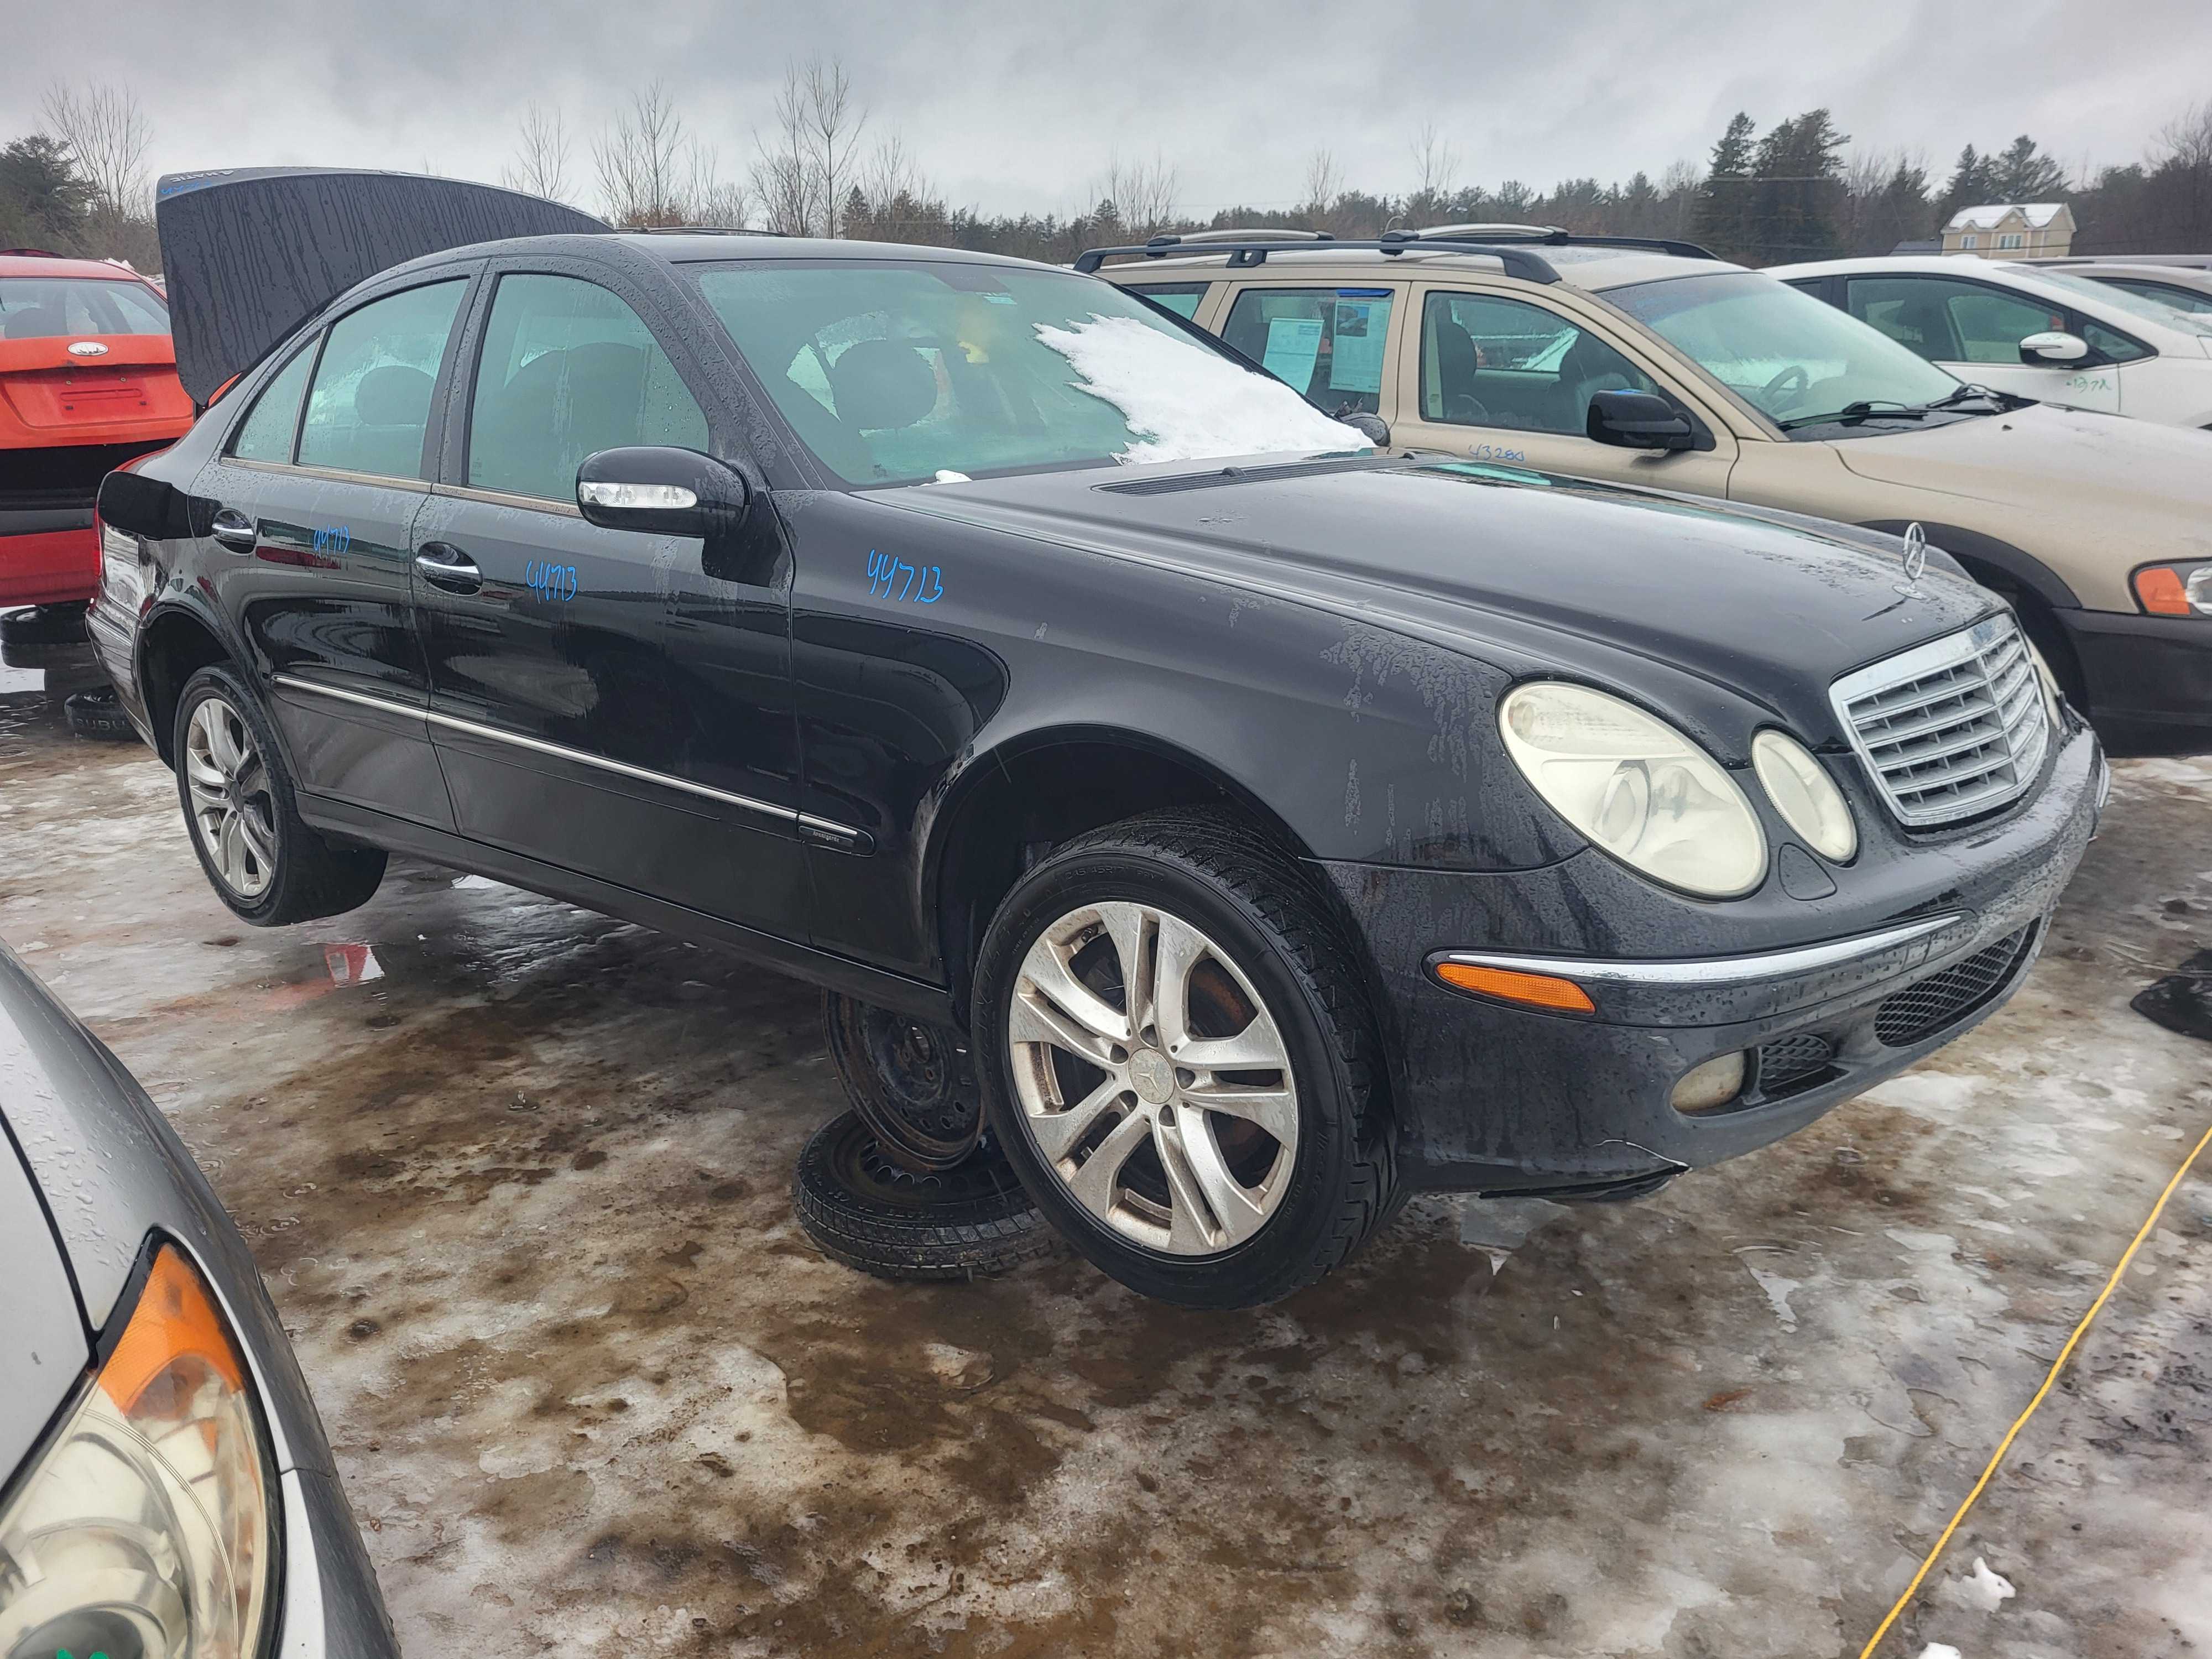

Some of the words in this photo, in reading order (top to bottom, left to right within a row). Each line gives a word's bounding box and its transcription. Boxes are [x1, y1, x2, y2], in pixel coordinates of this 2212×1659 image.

[1468, 444, 1525, 462] 43280
[526, 560, 577, 604] 44713
[867, 549, 944, 603] 44713
